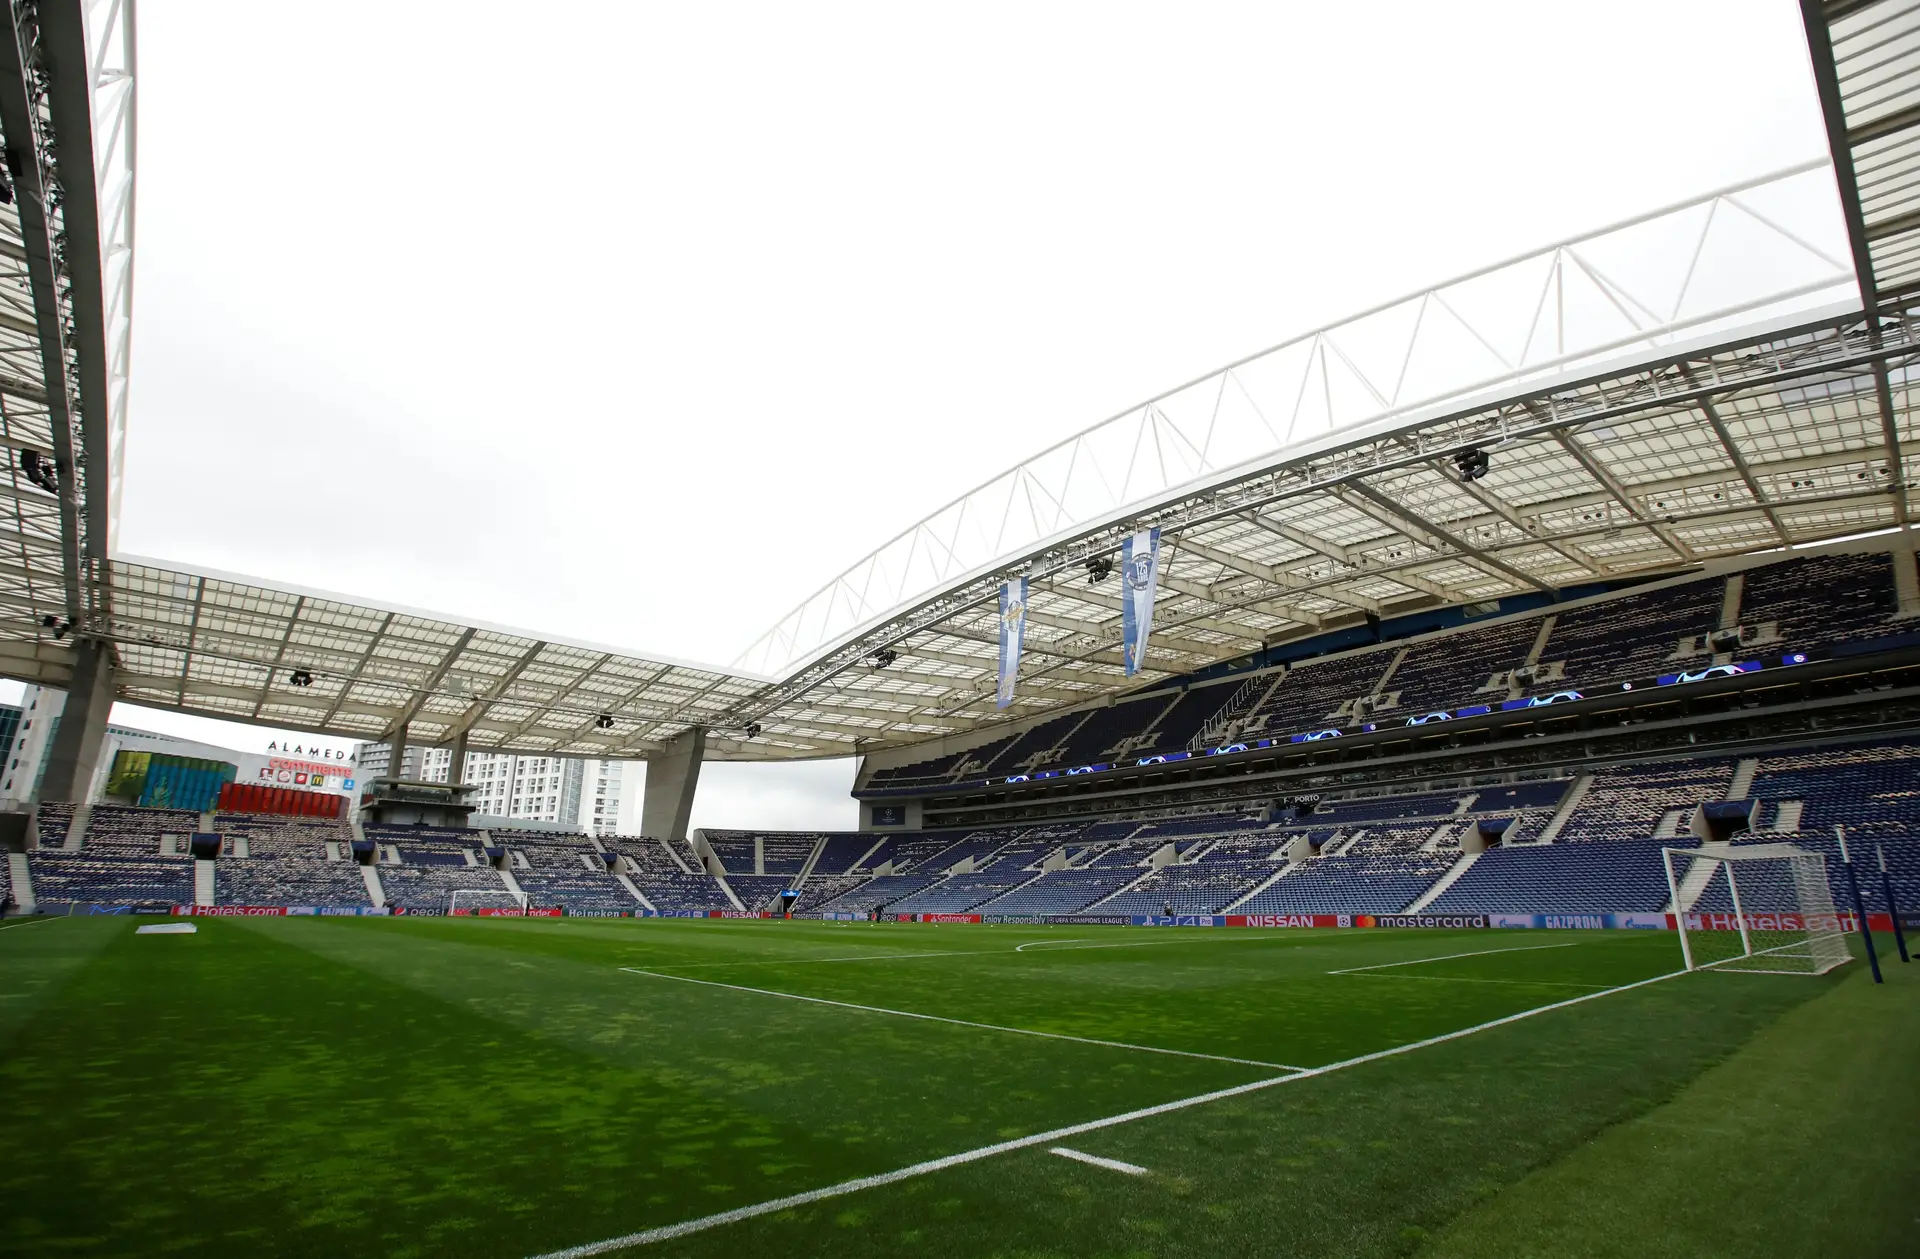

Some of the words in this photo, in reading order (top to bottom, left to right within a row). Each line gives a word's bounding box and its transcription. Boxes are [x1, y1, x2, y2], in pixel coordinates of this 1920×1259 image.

[1136, 560, 1148, 575] 125
[268, 740, 358, 763] ALAMEDA
[1294, 794, 1320, 803] PORTO
[196, 906, 279, 916] Hotels.com
[321, 907, 357, 916] GAZPROM
[410, 908, 444, 916] pepsi
[568, 909, 620, 918] Heineken
[721, 911, 760, 919] NISSAN
[792, 912, 823, 920] mastercard
[937, 914, 972, 923] Santander
[1102, 917, 1123, 925] LEAGUE
[1160, 916, 1197, 926] PS4
[1246, 915, 1314, 927] NISSAN
[1380, 915, 1484, 928] mastercard
[1545, 916, 1603, 929] GAZPROM
